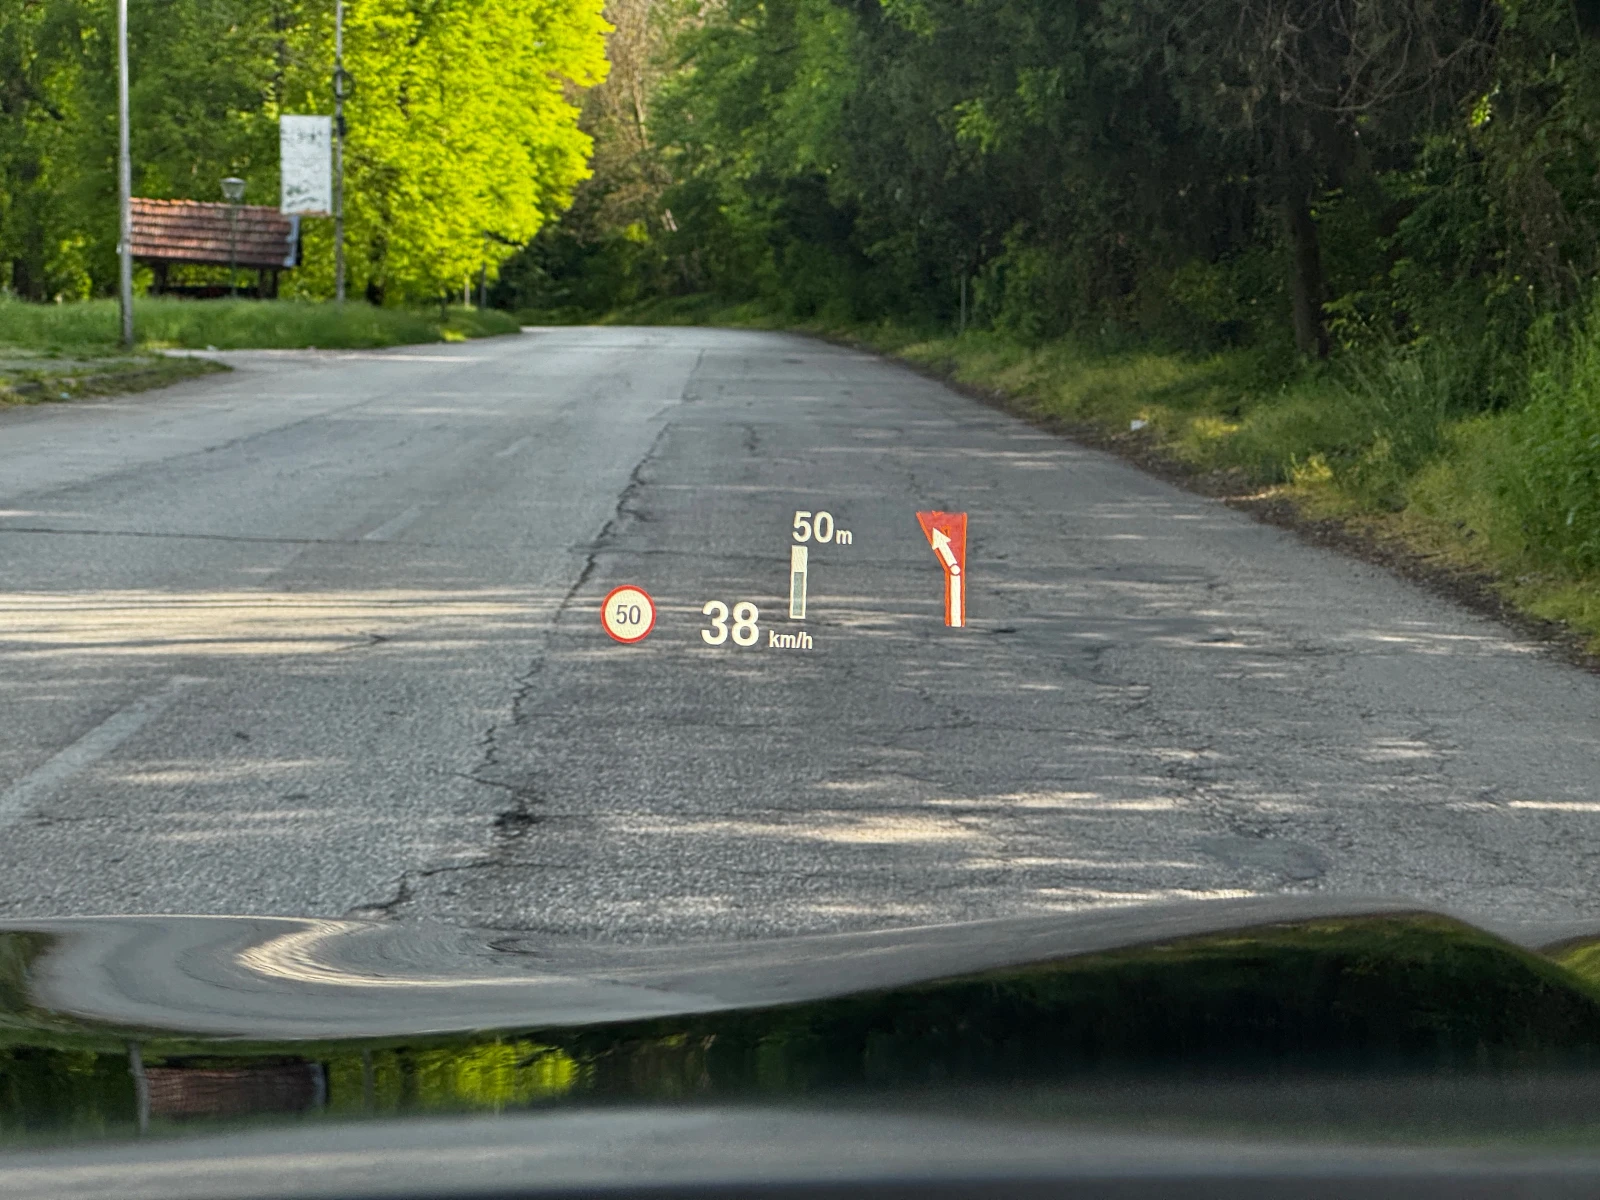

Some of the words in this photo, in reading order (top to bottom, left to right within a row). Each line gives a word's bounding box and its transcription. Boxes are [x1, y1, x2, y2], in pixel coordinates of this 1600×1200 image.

[615, 604, 642, 626] 50
[701, 600, 760, 647] 38
[769, 631, 813, 650] km/h
